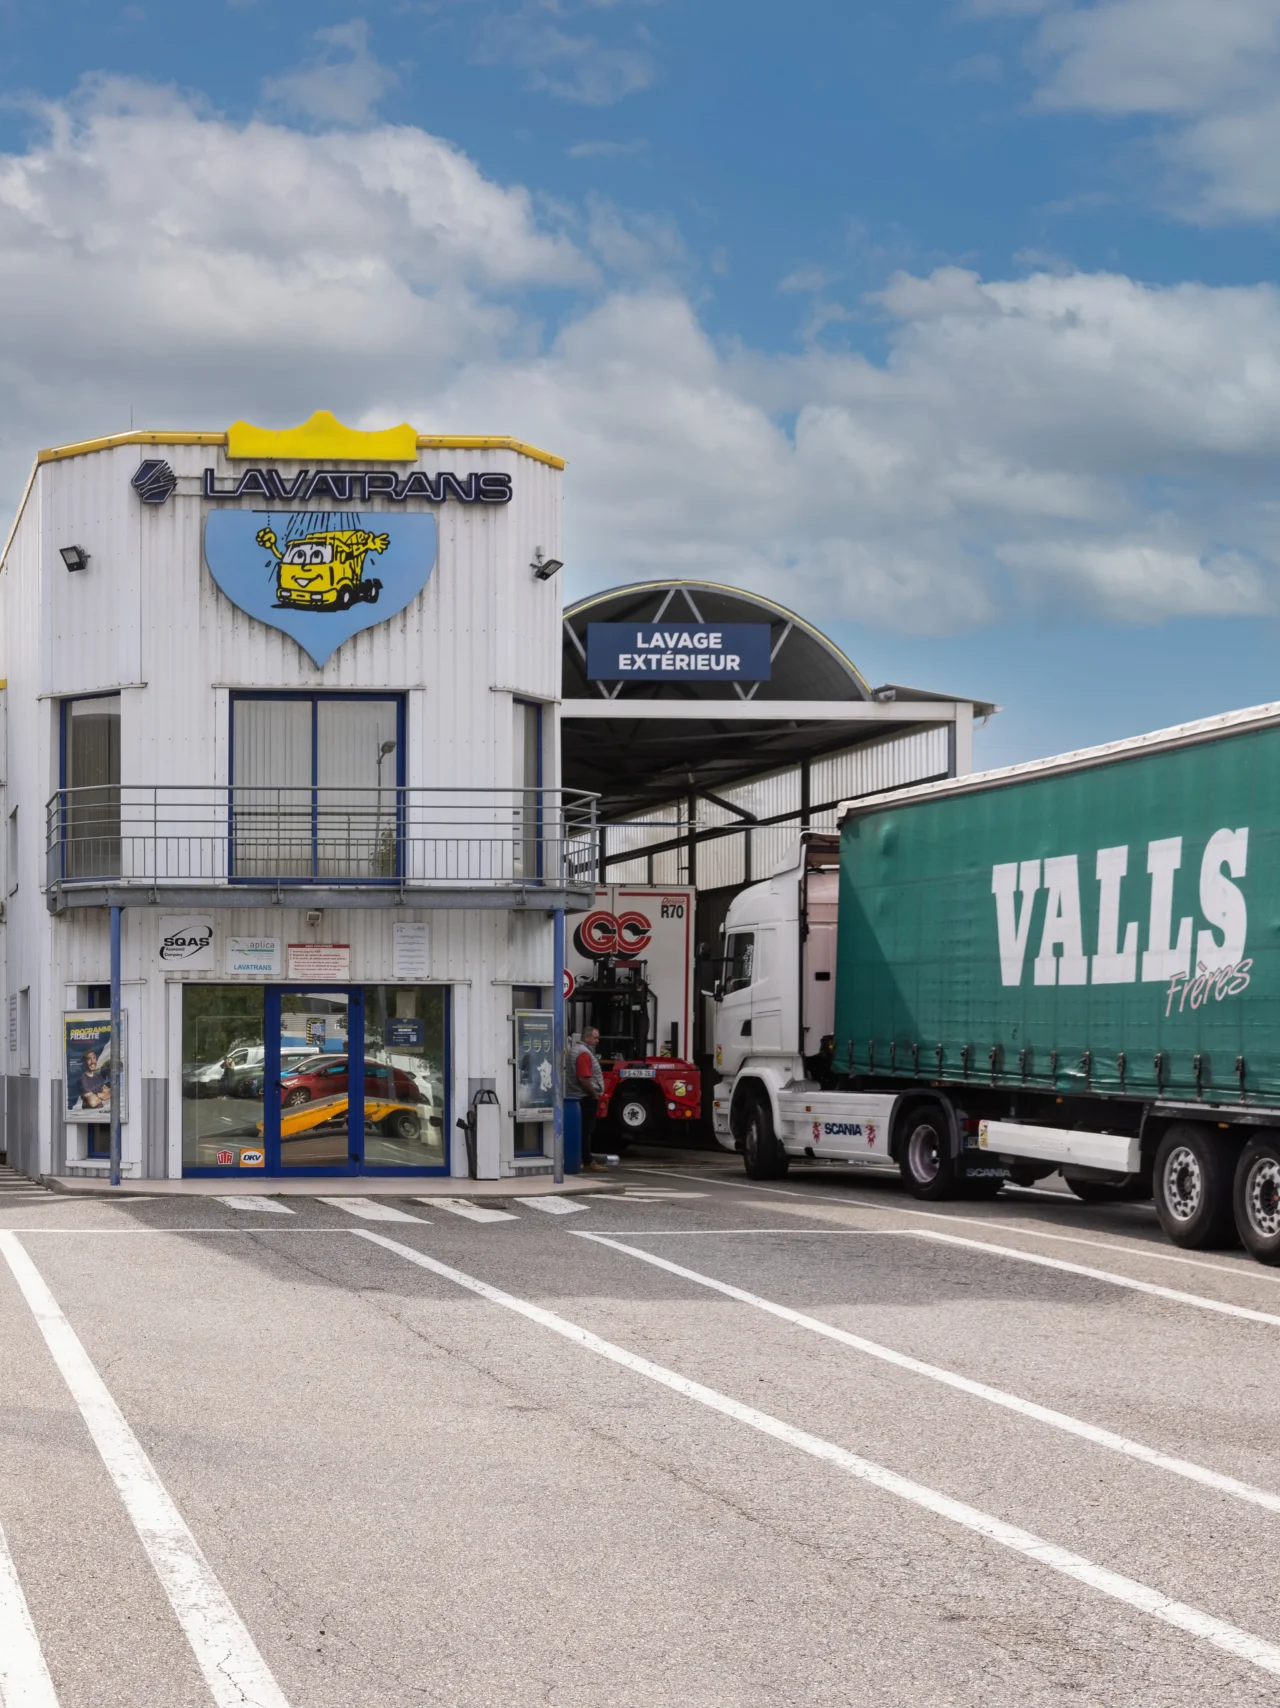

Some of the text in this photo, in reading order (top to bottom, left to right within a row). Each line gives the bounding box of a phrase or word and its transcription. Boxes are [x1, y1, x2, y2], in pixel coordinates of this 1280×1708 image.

[204, 468, 512, 504] LAVATRANS
[636, 632, 722, 649] LAVAGE
[618, 651, 740, 671] EXTÉRIEUR
[661, 904, 684, 919] R70
[991, 827, 1249, 986] VALLS
[163, 937, 210, 946] SQAS
[249, 940, 275, 950] aplica
[1164, 958, 1253, 1017] Frères
[824, 1122, 862, 1136] SCANIA
[965, 1167, 1012, 1177] SCANIA
